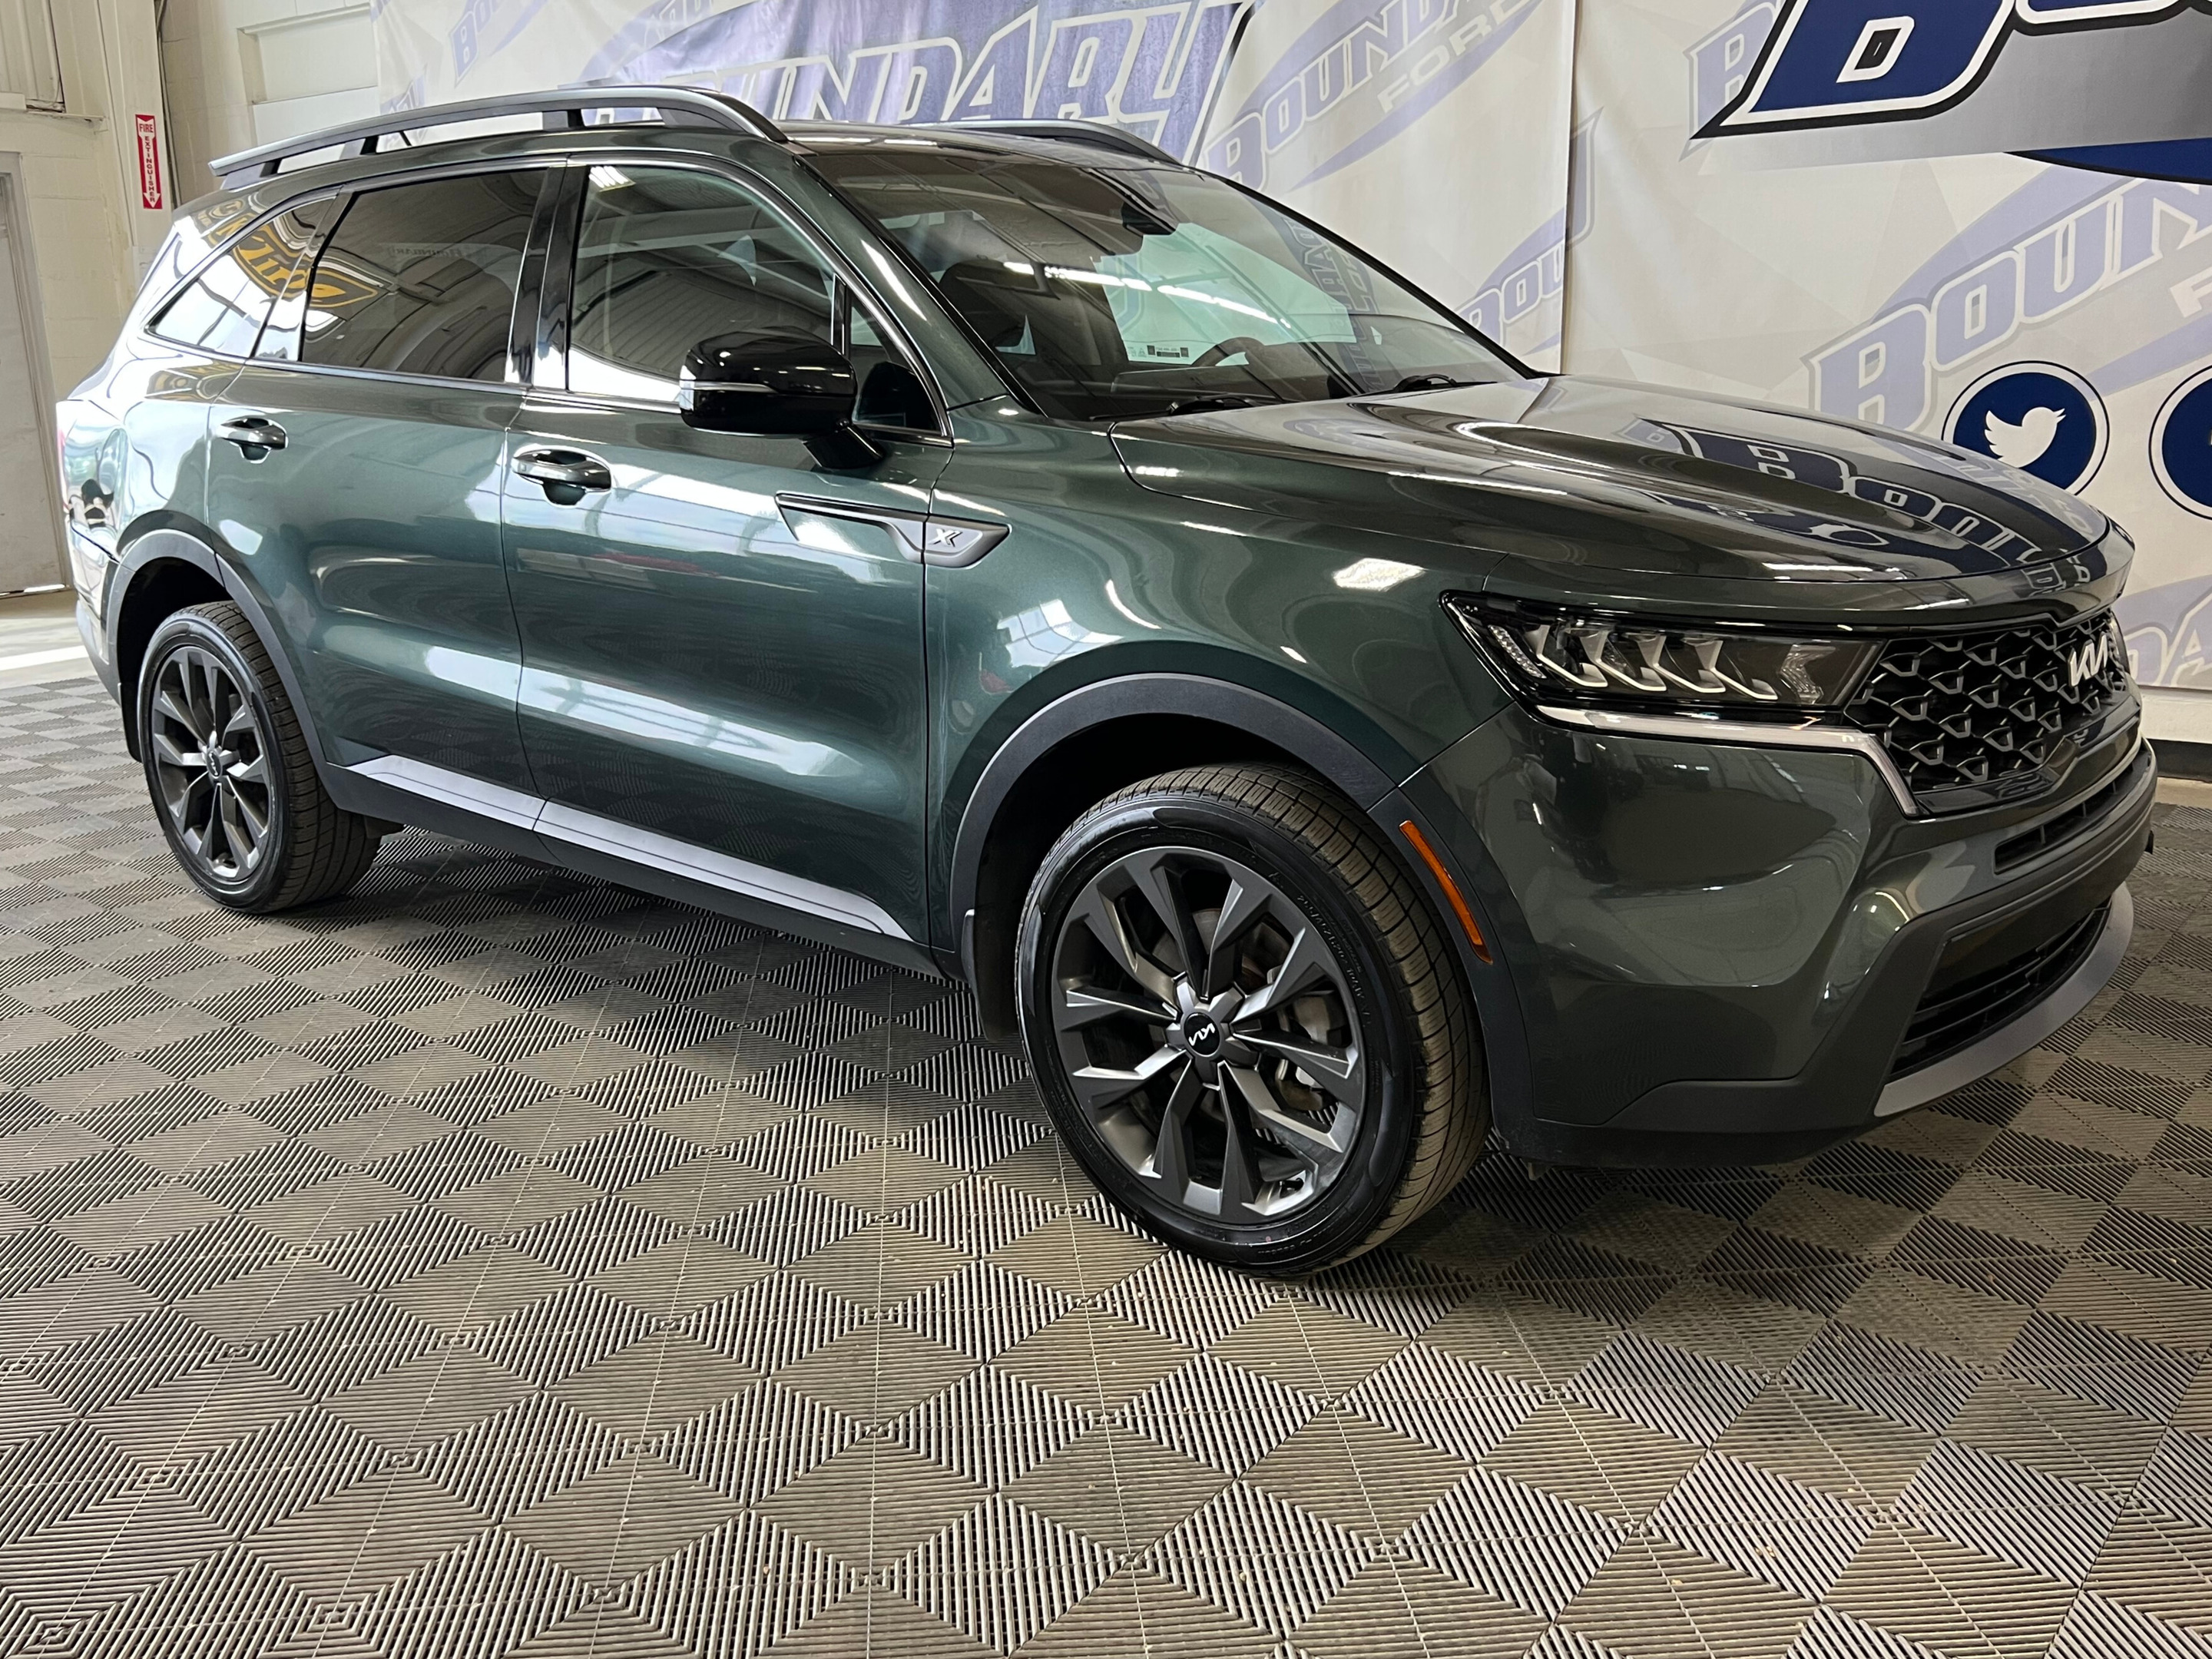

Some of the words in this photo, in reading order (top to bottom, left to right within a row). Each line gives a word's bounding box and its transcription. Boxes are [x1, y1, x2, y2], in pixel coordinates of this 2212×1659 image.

[138, 123, 154, 134] FIRE
[144, 135, 156, 203] EXTINGUISHER
[2066, 631, 2109, 688] KIA
